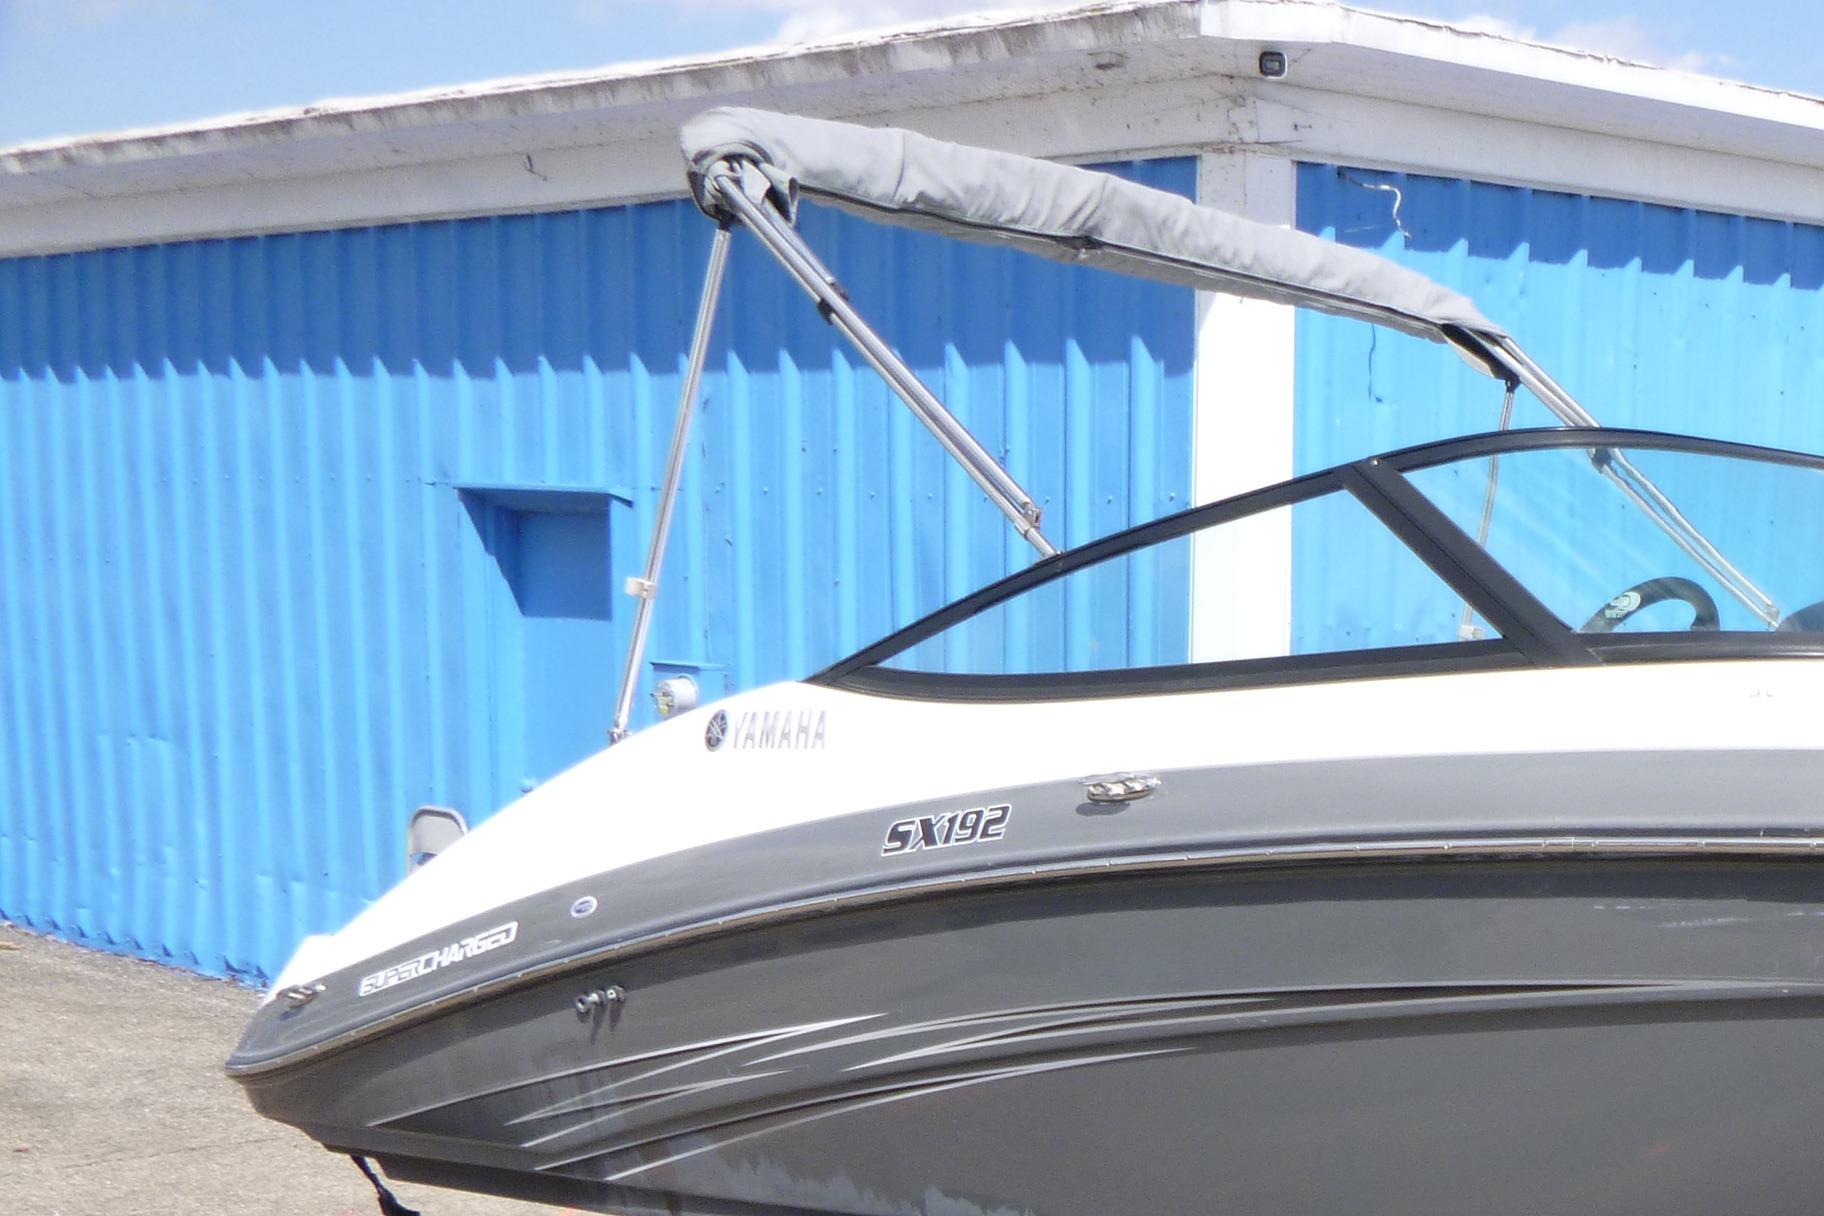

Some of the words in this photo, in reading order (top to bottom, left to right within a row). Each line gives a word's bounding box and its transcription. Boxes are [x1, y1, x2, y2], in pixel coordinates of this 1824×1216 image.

[733, 710, 827, 750] YAMAHA
[881, 804, 1012, 856] SX192
[359, 921, 518, 997] SUPERCHARGED
